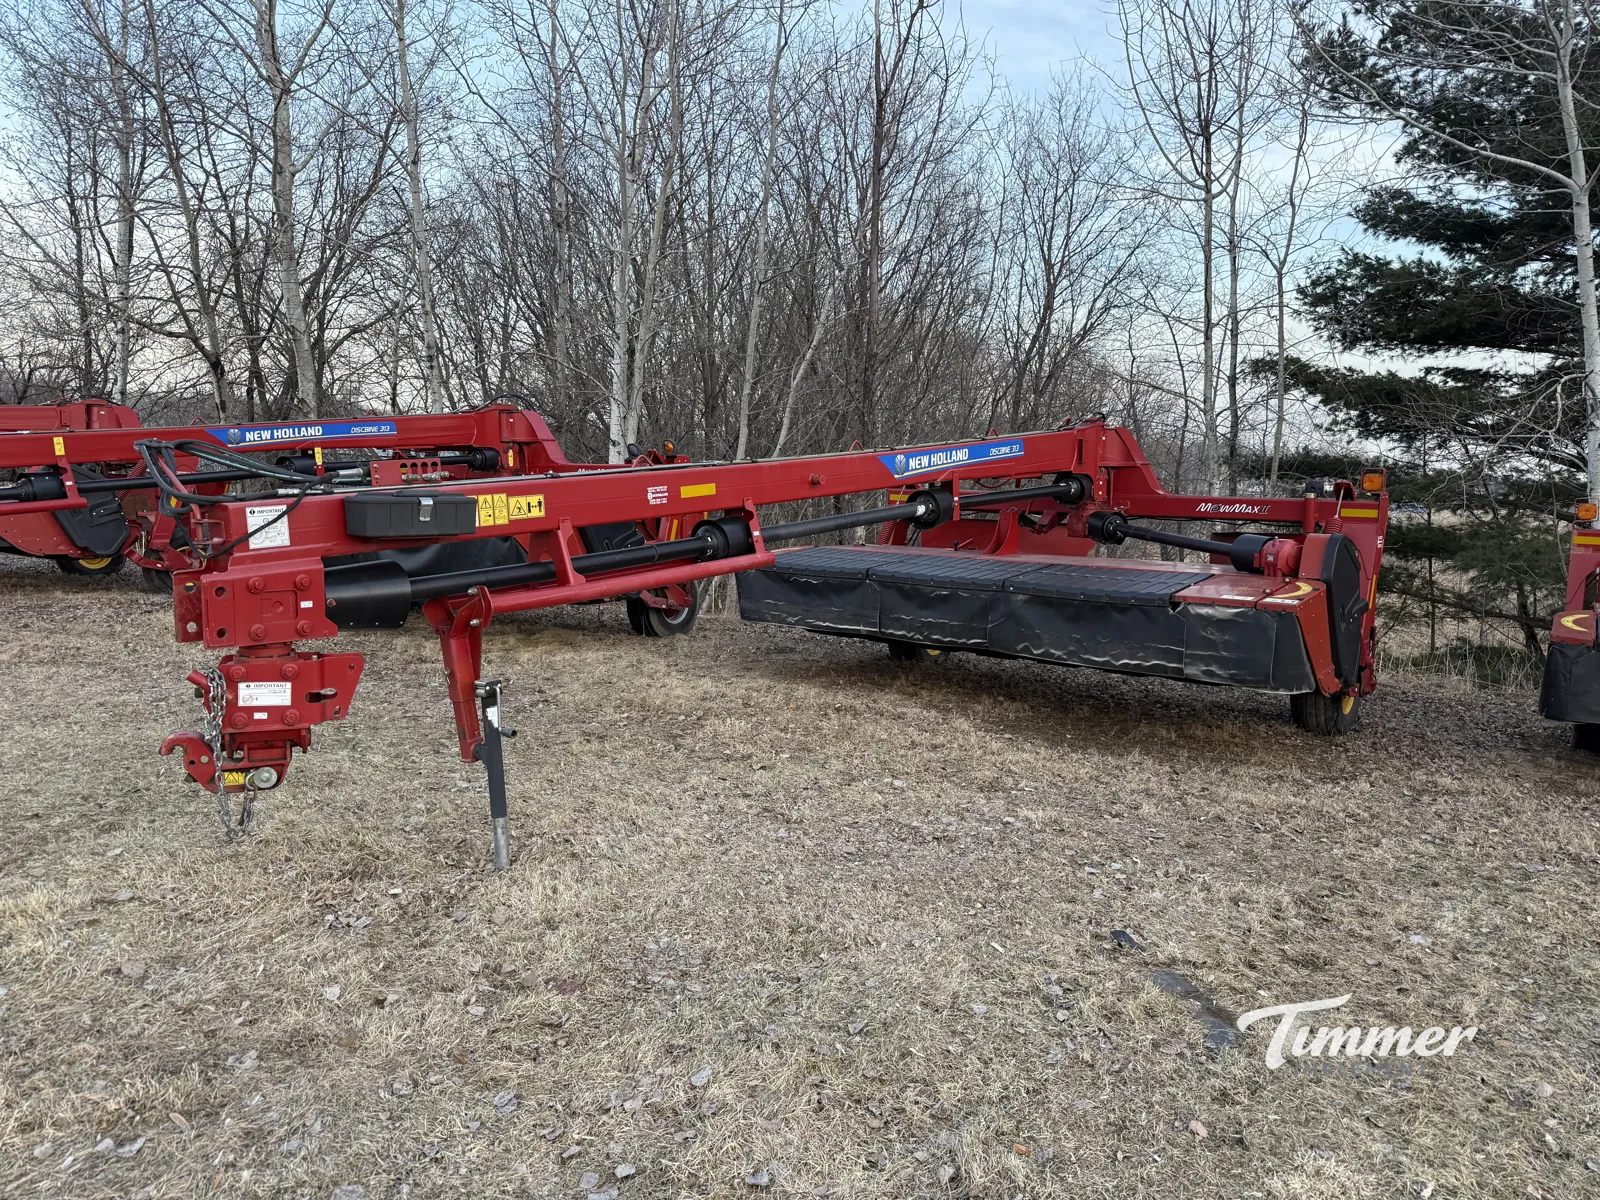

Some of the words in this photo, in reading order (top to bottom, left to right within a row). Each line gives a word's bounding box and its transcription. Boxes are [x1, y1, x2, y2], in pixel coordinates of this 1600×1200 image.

[245, 430, 273, 442] NEW
[274, 426, 323, 438] HOLLAND
[909, 455, 930, 471] NEW
[930, 448, 969, 467] HOLLAND
